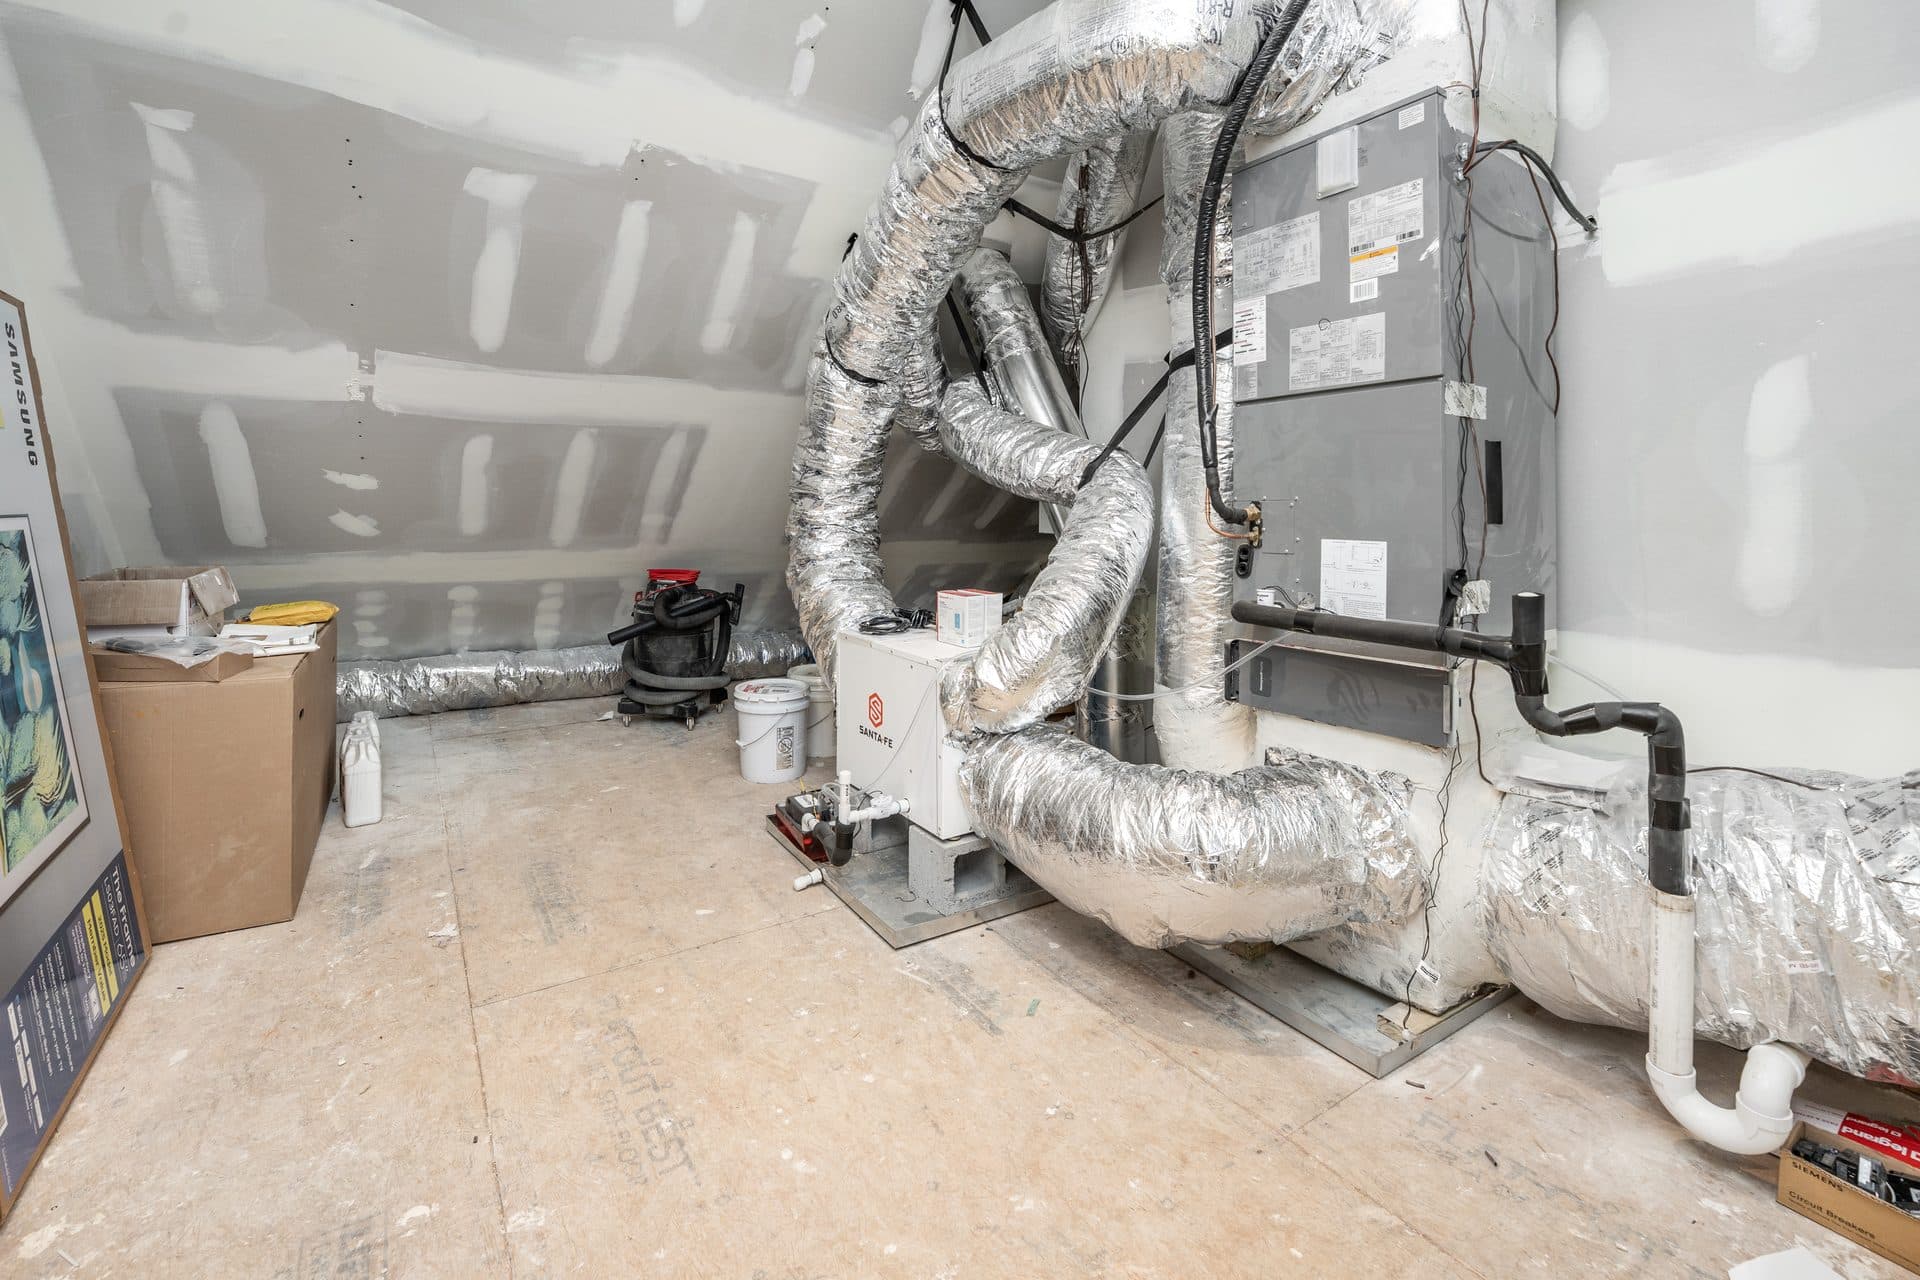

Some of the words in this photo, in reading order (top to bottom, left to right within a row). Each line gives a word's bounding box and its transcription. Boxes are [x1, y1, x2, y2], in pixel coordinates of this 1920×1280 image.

[5, 322, 38, 466] SAMSUNG
[103, 876, 121, 937] LS03FAD
[112, 865, 123, 903] The
[119, 905, 136, 968] Frame
[1841, 1125, 1908, 1156] legrand
[1844, 1116, 1889, 1133] legrand
[1791, 1161, 1844, 1193] SIEMENS
[1788, 1190, 1824, 1213] Circuit
[1826, 1209, 1877, 1239] Breakers
